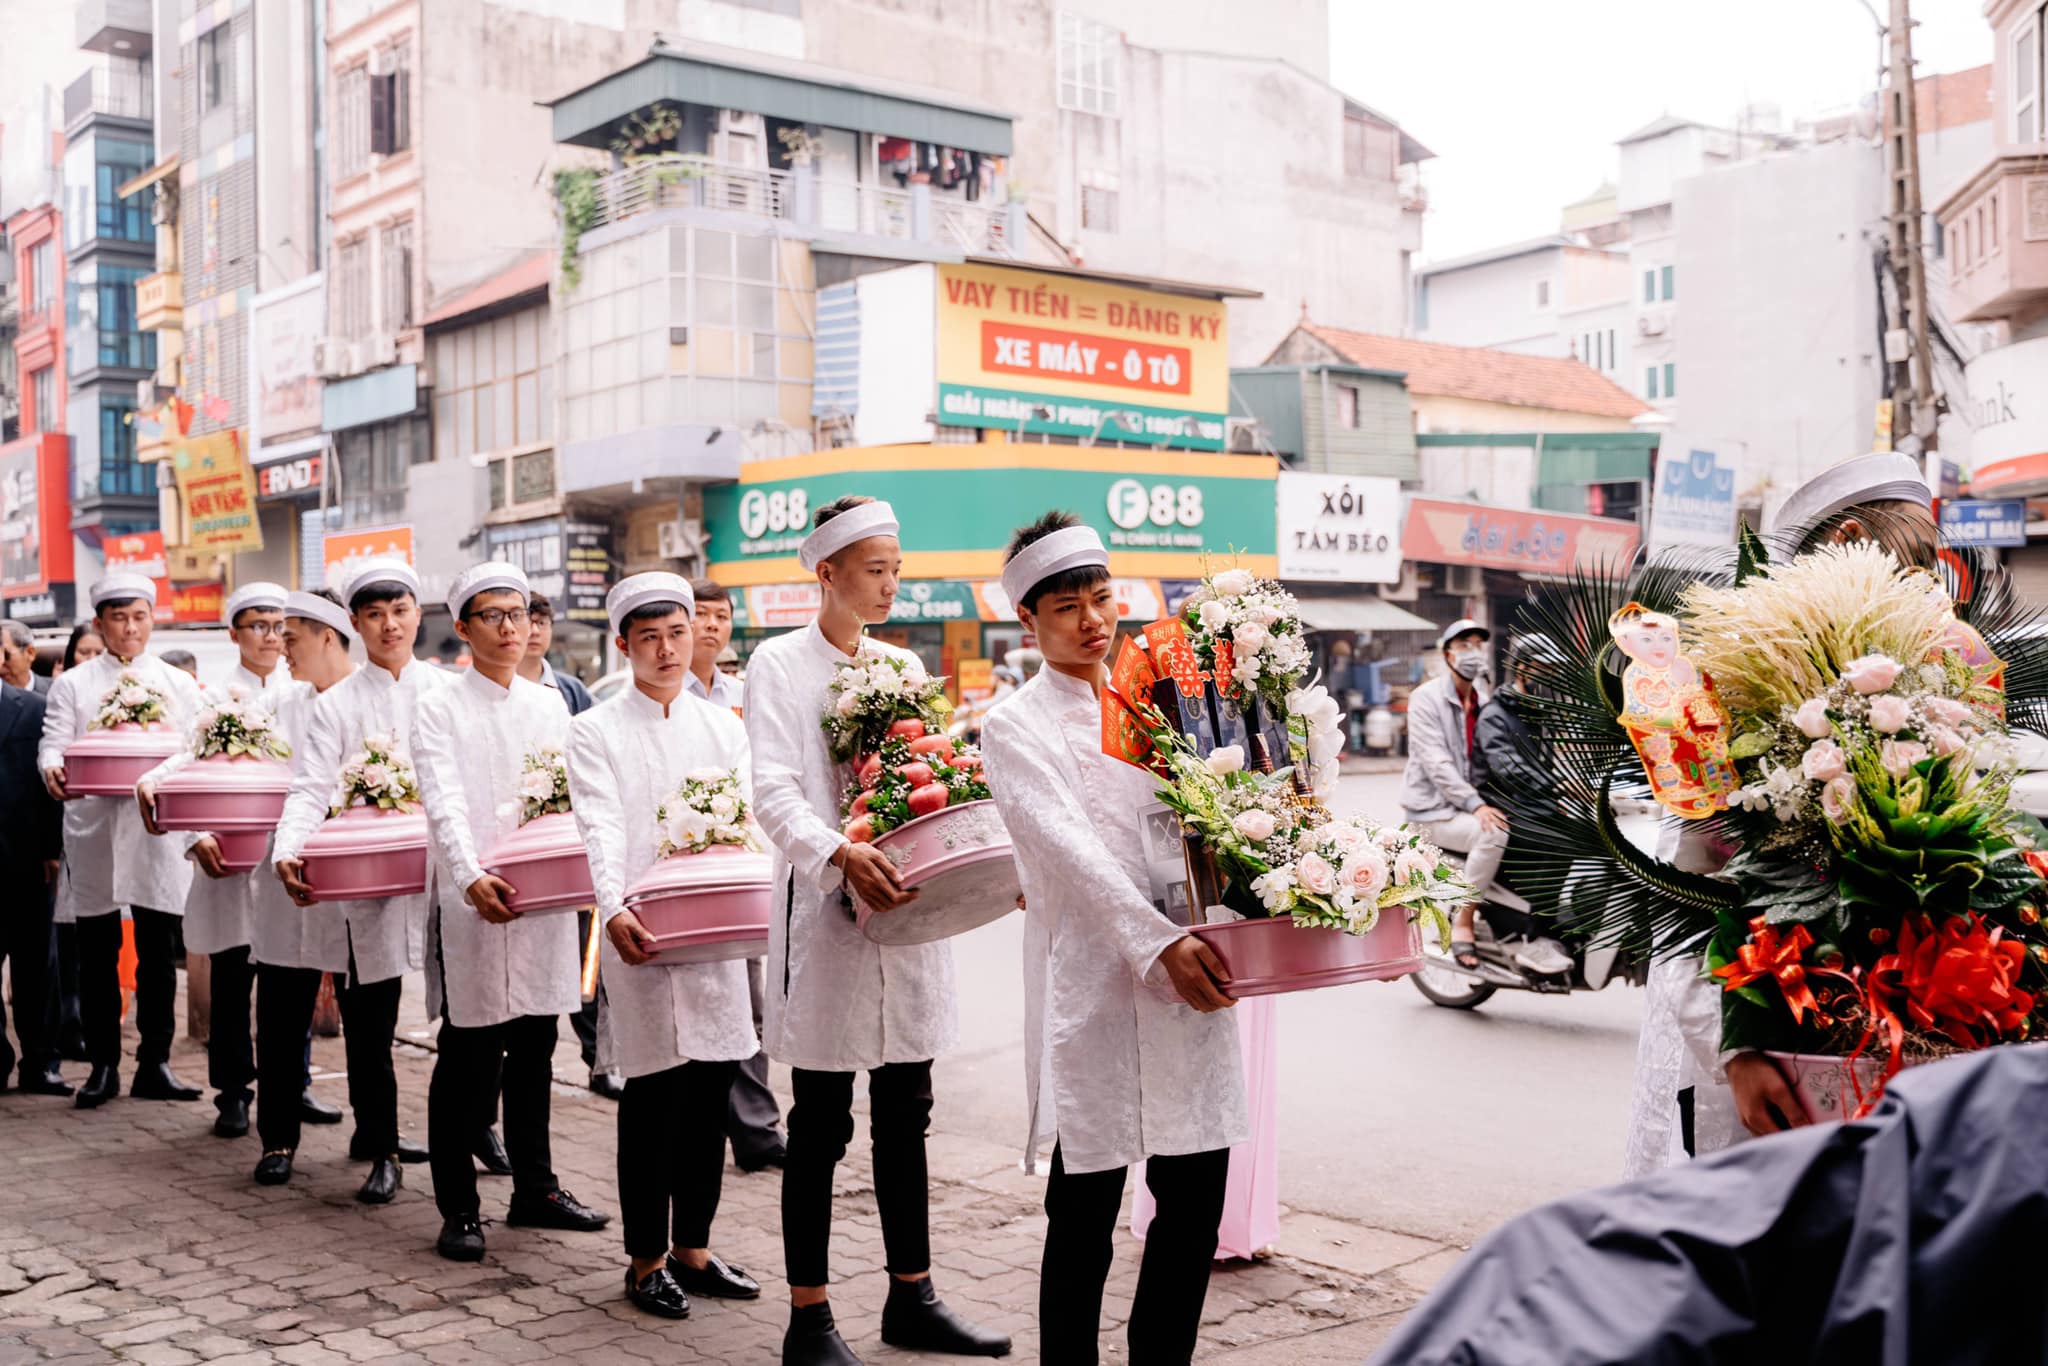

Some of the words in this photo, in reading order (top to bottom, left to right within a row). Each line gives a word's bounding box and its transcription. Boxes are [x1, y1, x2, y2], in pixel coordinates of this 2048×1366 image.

[946, 277, 996, 309] VAY
[994, 335, 1031, 367] XE
[1038, 340, 1099, 376] MÁY
[1123, 347, 1143, 381] Ô
[1147, 354, 1180, 386] TÔ
[739, 488, 808, 538] F88
[1107, 479, 1204, 528] F88
[1322, 483, 1364, 515] XÔI
